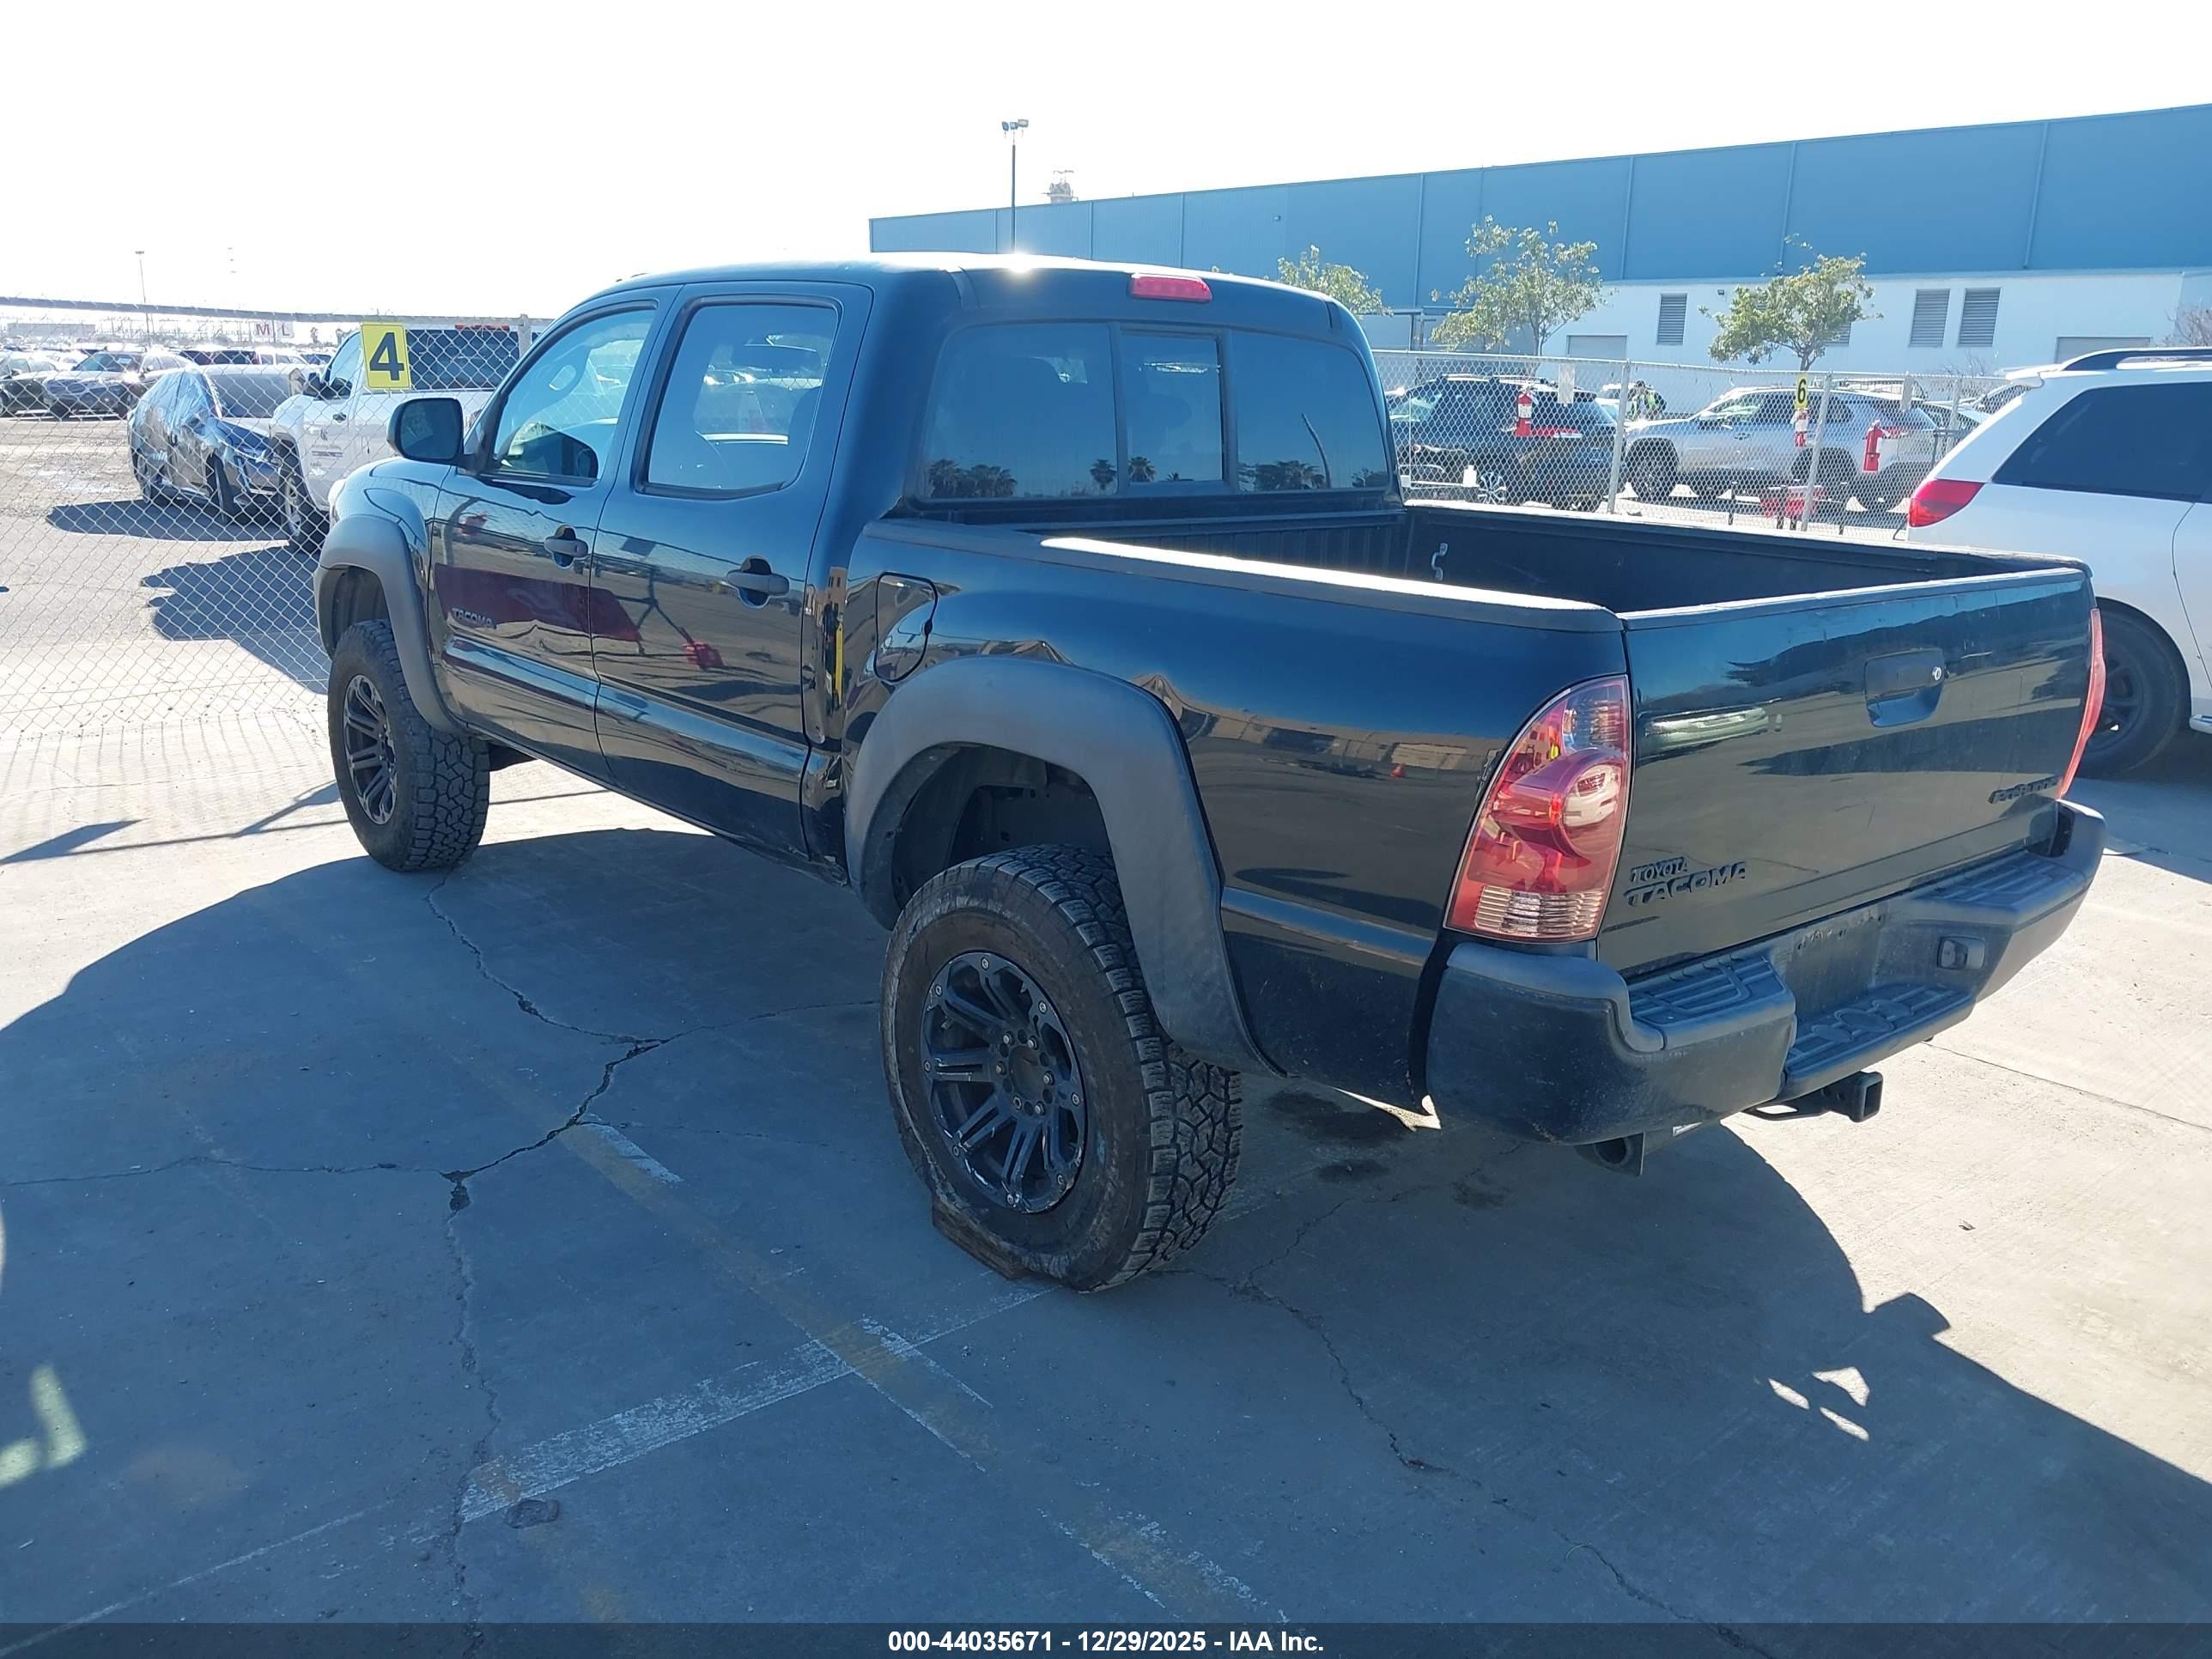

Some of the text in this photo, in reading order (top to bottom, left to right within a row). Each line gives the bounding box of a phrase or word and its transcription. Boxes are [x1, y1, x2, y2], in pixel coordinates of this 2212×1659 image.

[369, 331, 404, 381] 4
[1797, 378, 1807, 404] 6
[452, 606, 497, 629] TACOMA
[1632, 857, 1687, 883] TOYOTA
[1624, 861, 1746, 907] TACOMA
